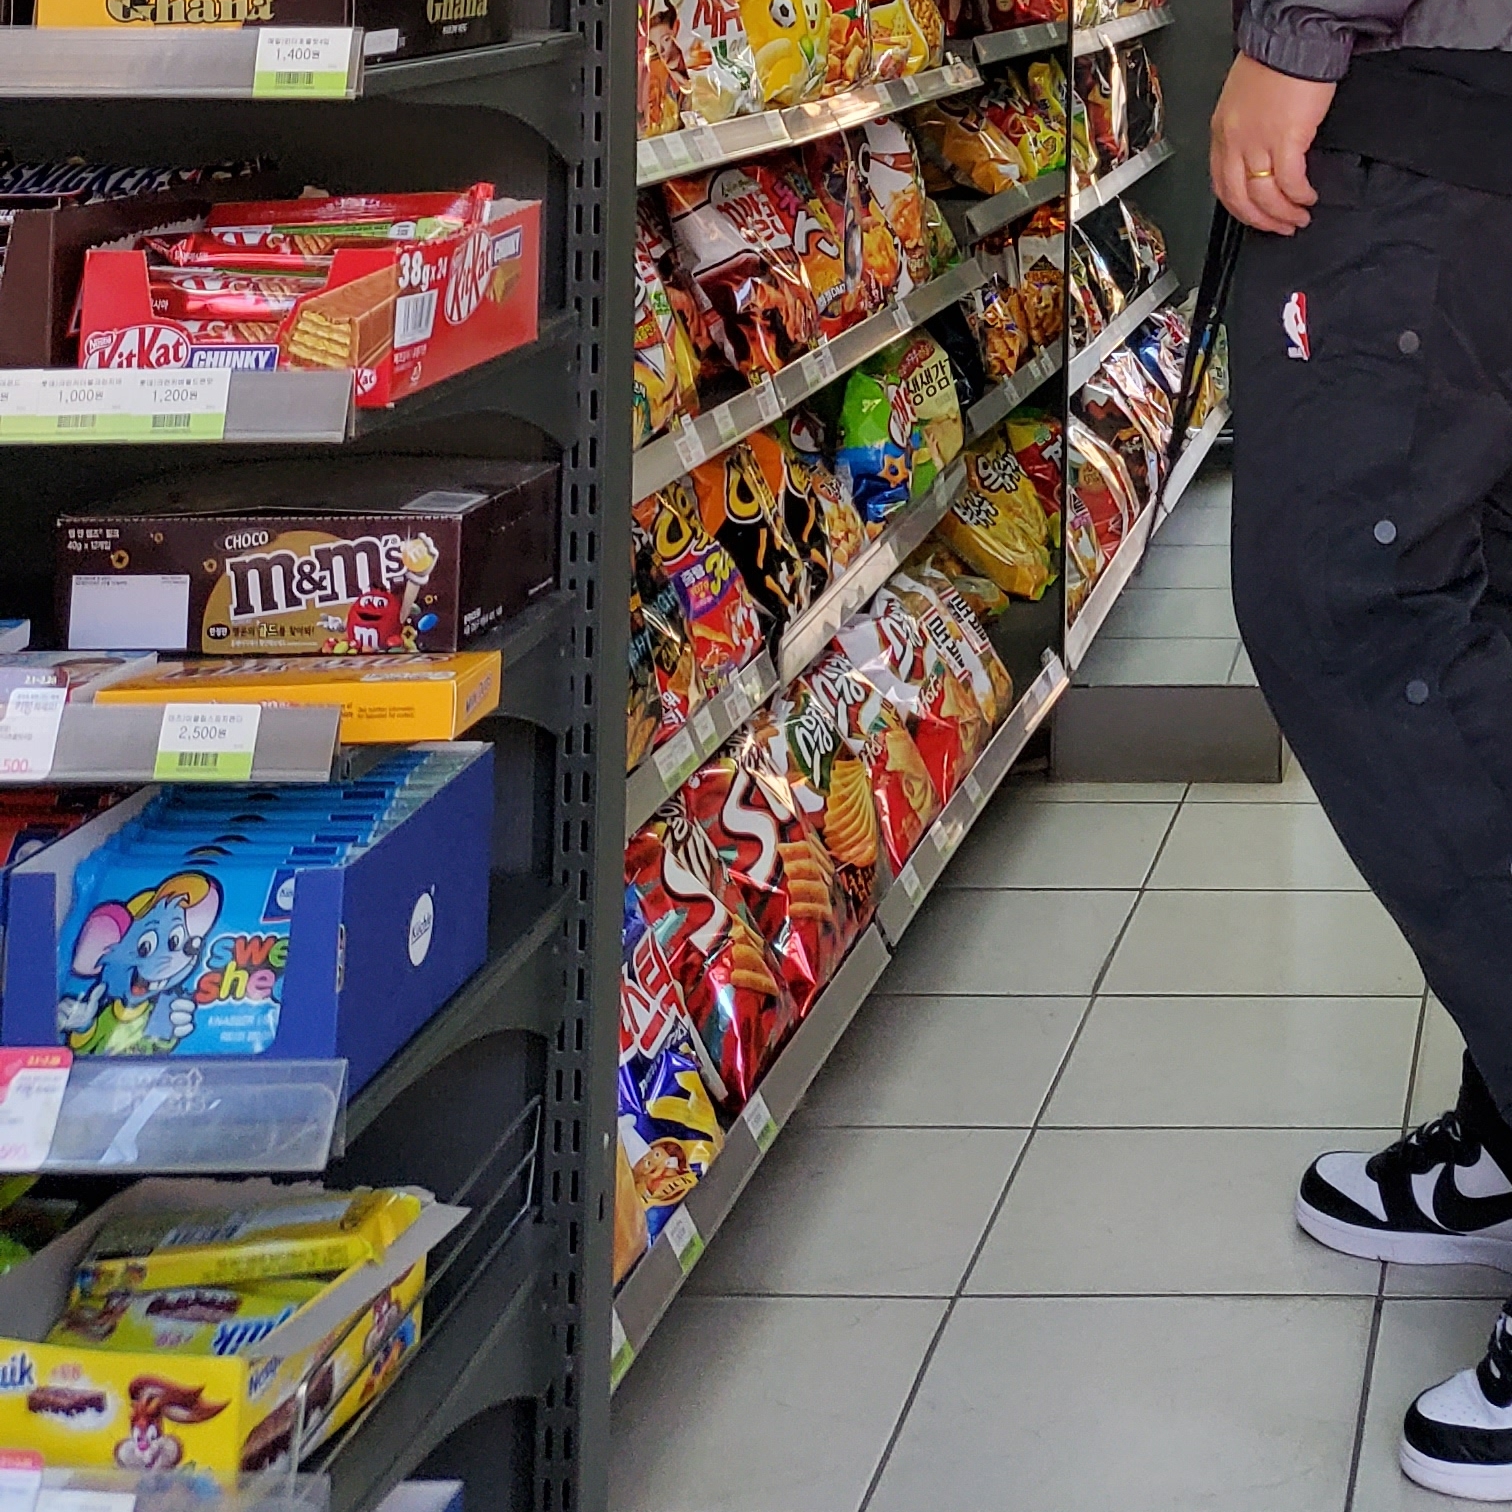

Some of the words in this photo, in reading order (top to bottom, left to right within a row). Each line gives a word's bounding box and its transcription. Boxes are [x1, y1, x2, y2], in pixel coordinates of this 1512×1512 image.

[275, 48, 320, 60] 1,400원
[445, 229, 492, 325] KitKat
[94, 326, 185, 369] KitKat
[192, 348, 271, 371] CHUNKY
[58, 389, 104, 403] 1,000원
[152, 389, 198, 402] 1,200원
[224, 530, 269, 551] CHOCO
[226, 536, 406, 623] m&m's
[178, 725, 227, 739] 2,500원
